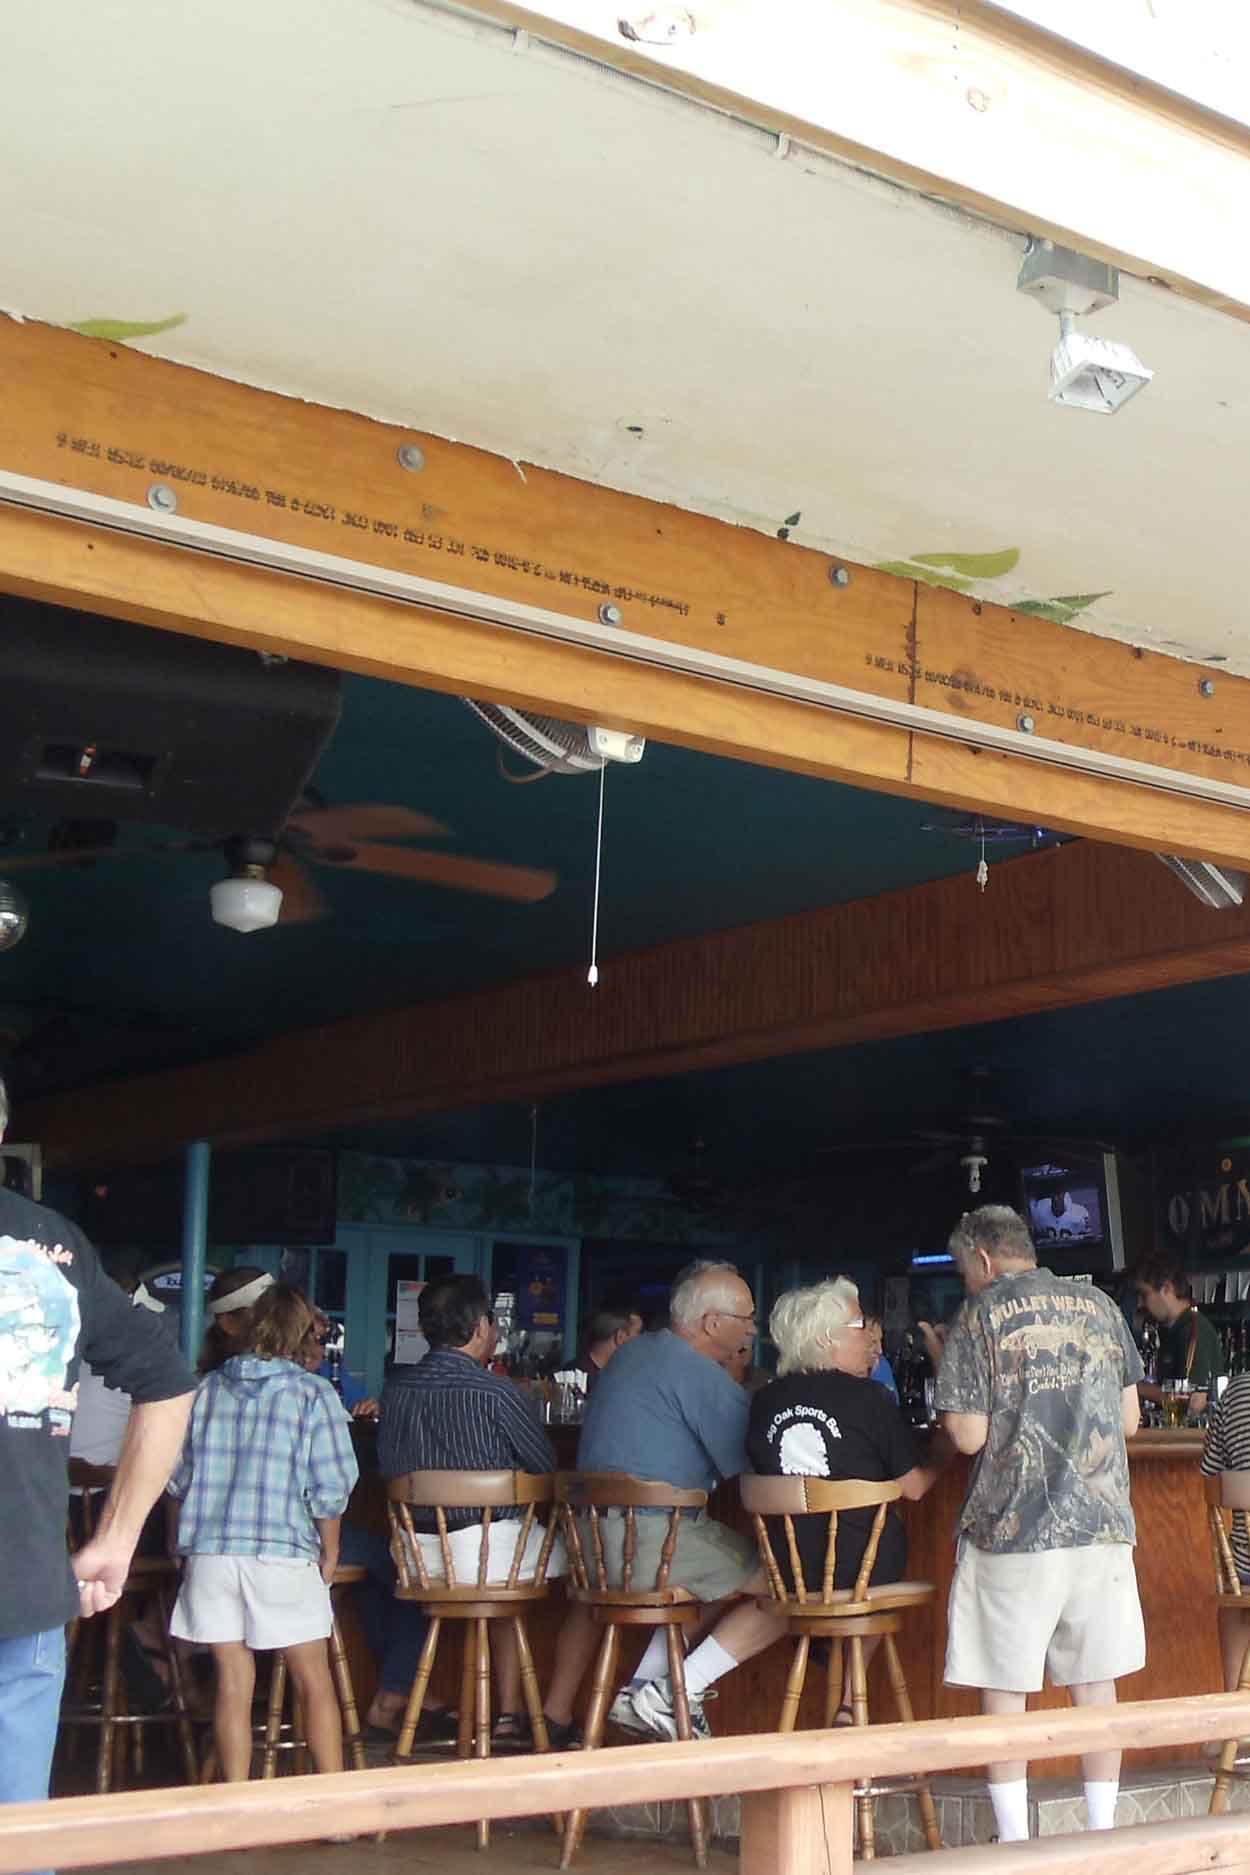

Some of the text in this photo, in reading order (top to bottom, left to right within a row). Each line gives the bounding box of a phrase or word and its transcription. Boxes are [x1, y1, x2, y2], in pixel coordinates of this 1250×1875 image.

[989, 1295, 1096, 1328] MULLET WEAR
[774, 1409, 793, 1425] Oak
[795, 1405, 828, 1422] Sports
[826, 1418, 842, 1439] Bar
